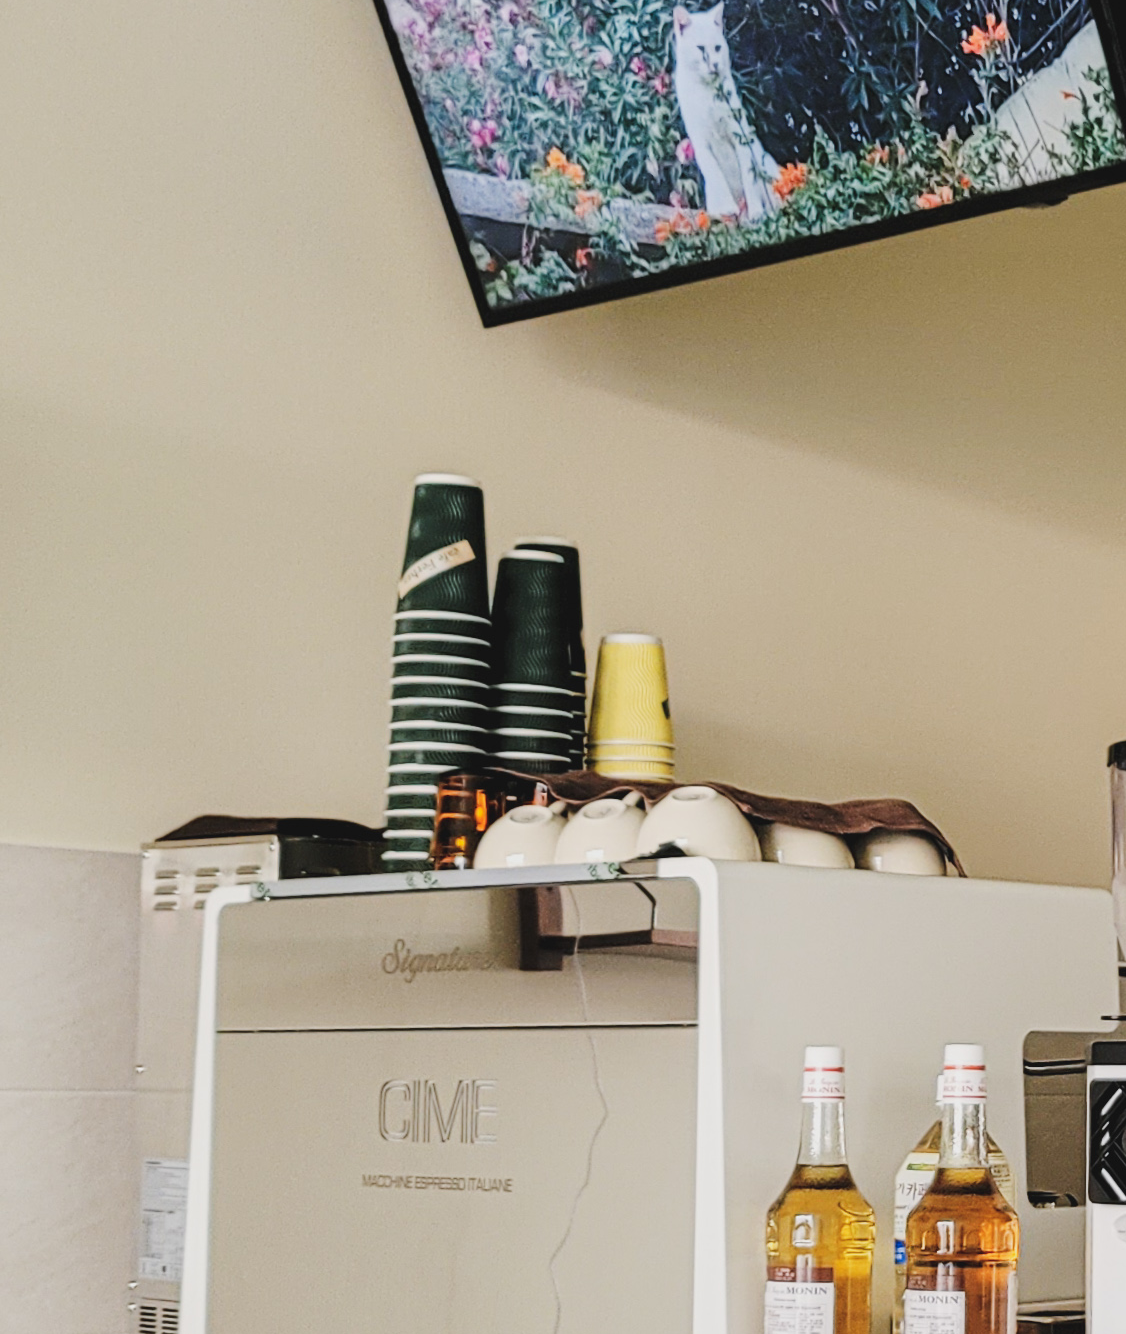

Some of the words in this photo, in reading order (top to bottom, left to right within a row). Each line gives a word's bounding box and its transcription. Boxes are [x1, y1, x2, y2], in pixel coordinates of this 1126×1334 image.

[378, 1078, 499, 1144] CIME
[414, 1175, 467, 1192] ESPRESSO
[467, 1177, 514, 1193] ITALIANE
[785, 1286, 828, 1296] MONIN
[918, 1295, 960, 1305] MONIN
